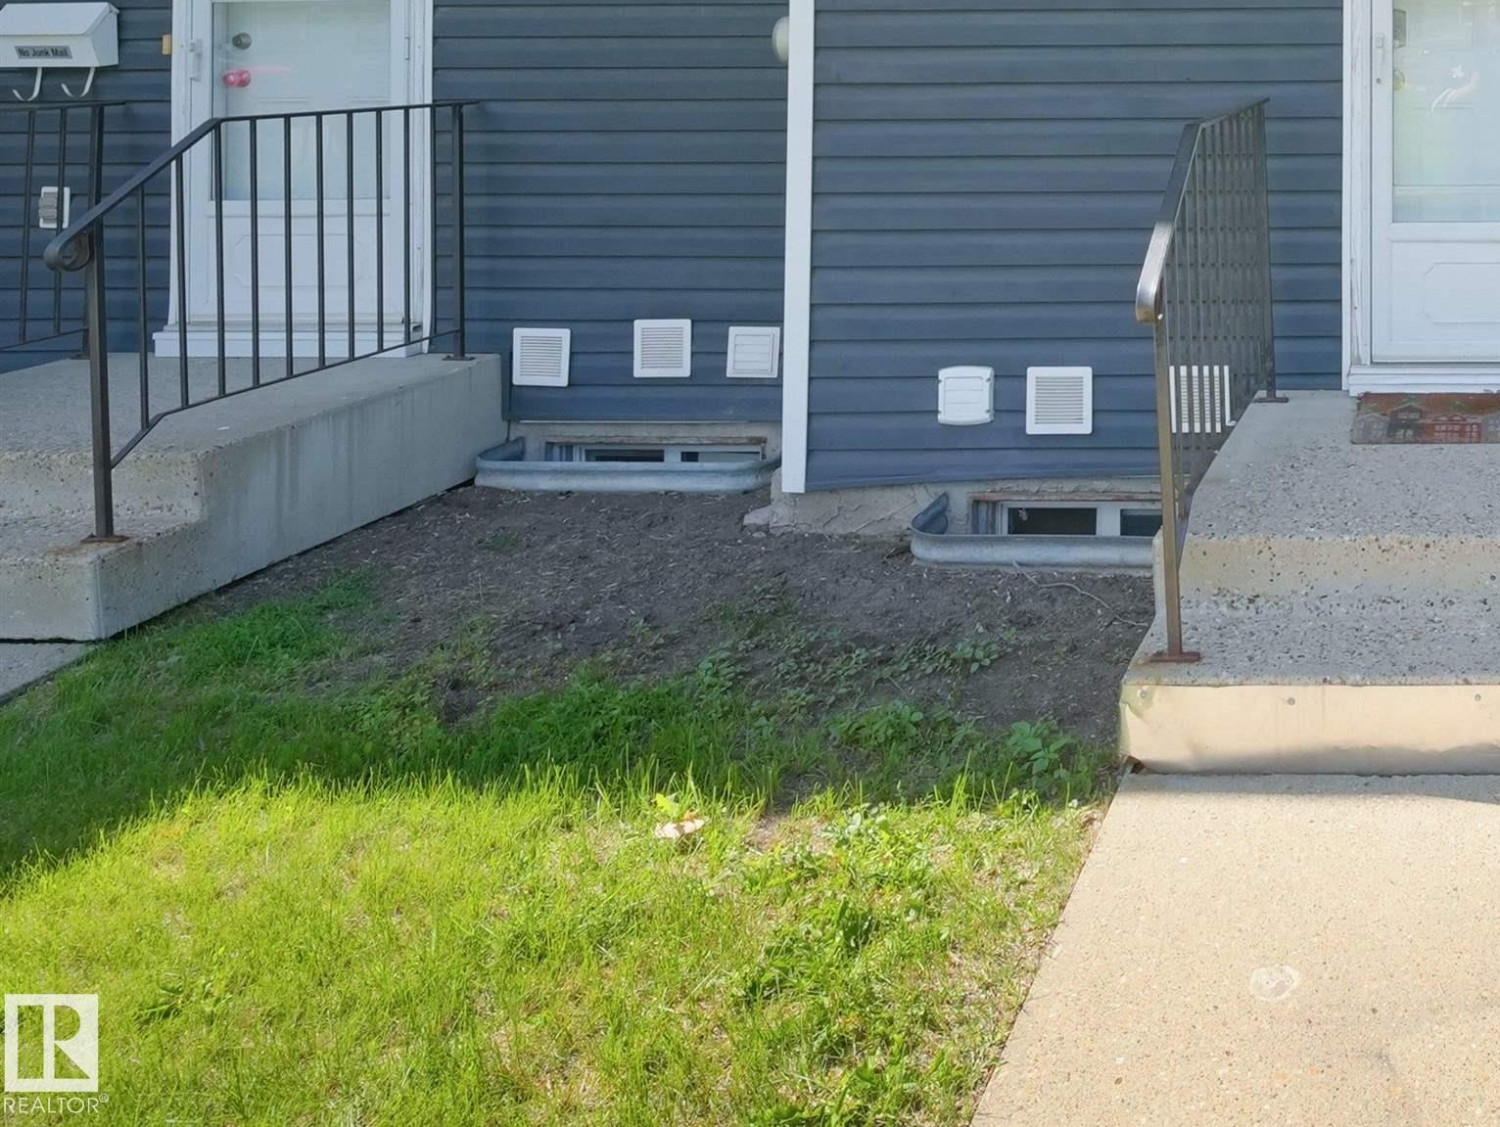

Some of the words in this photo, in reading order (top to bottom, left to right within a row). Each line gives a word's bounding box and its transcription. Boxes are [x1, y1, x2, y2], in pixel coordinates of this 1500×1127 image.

[18, 47, 30, 57] No
[32, 47, 51, 57] Junk
[51, 47, 69, 57] Mail
